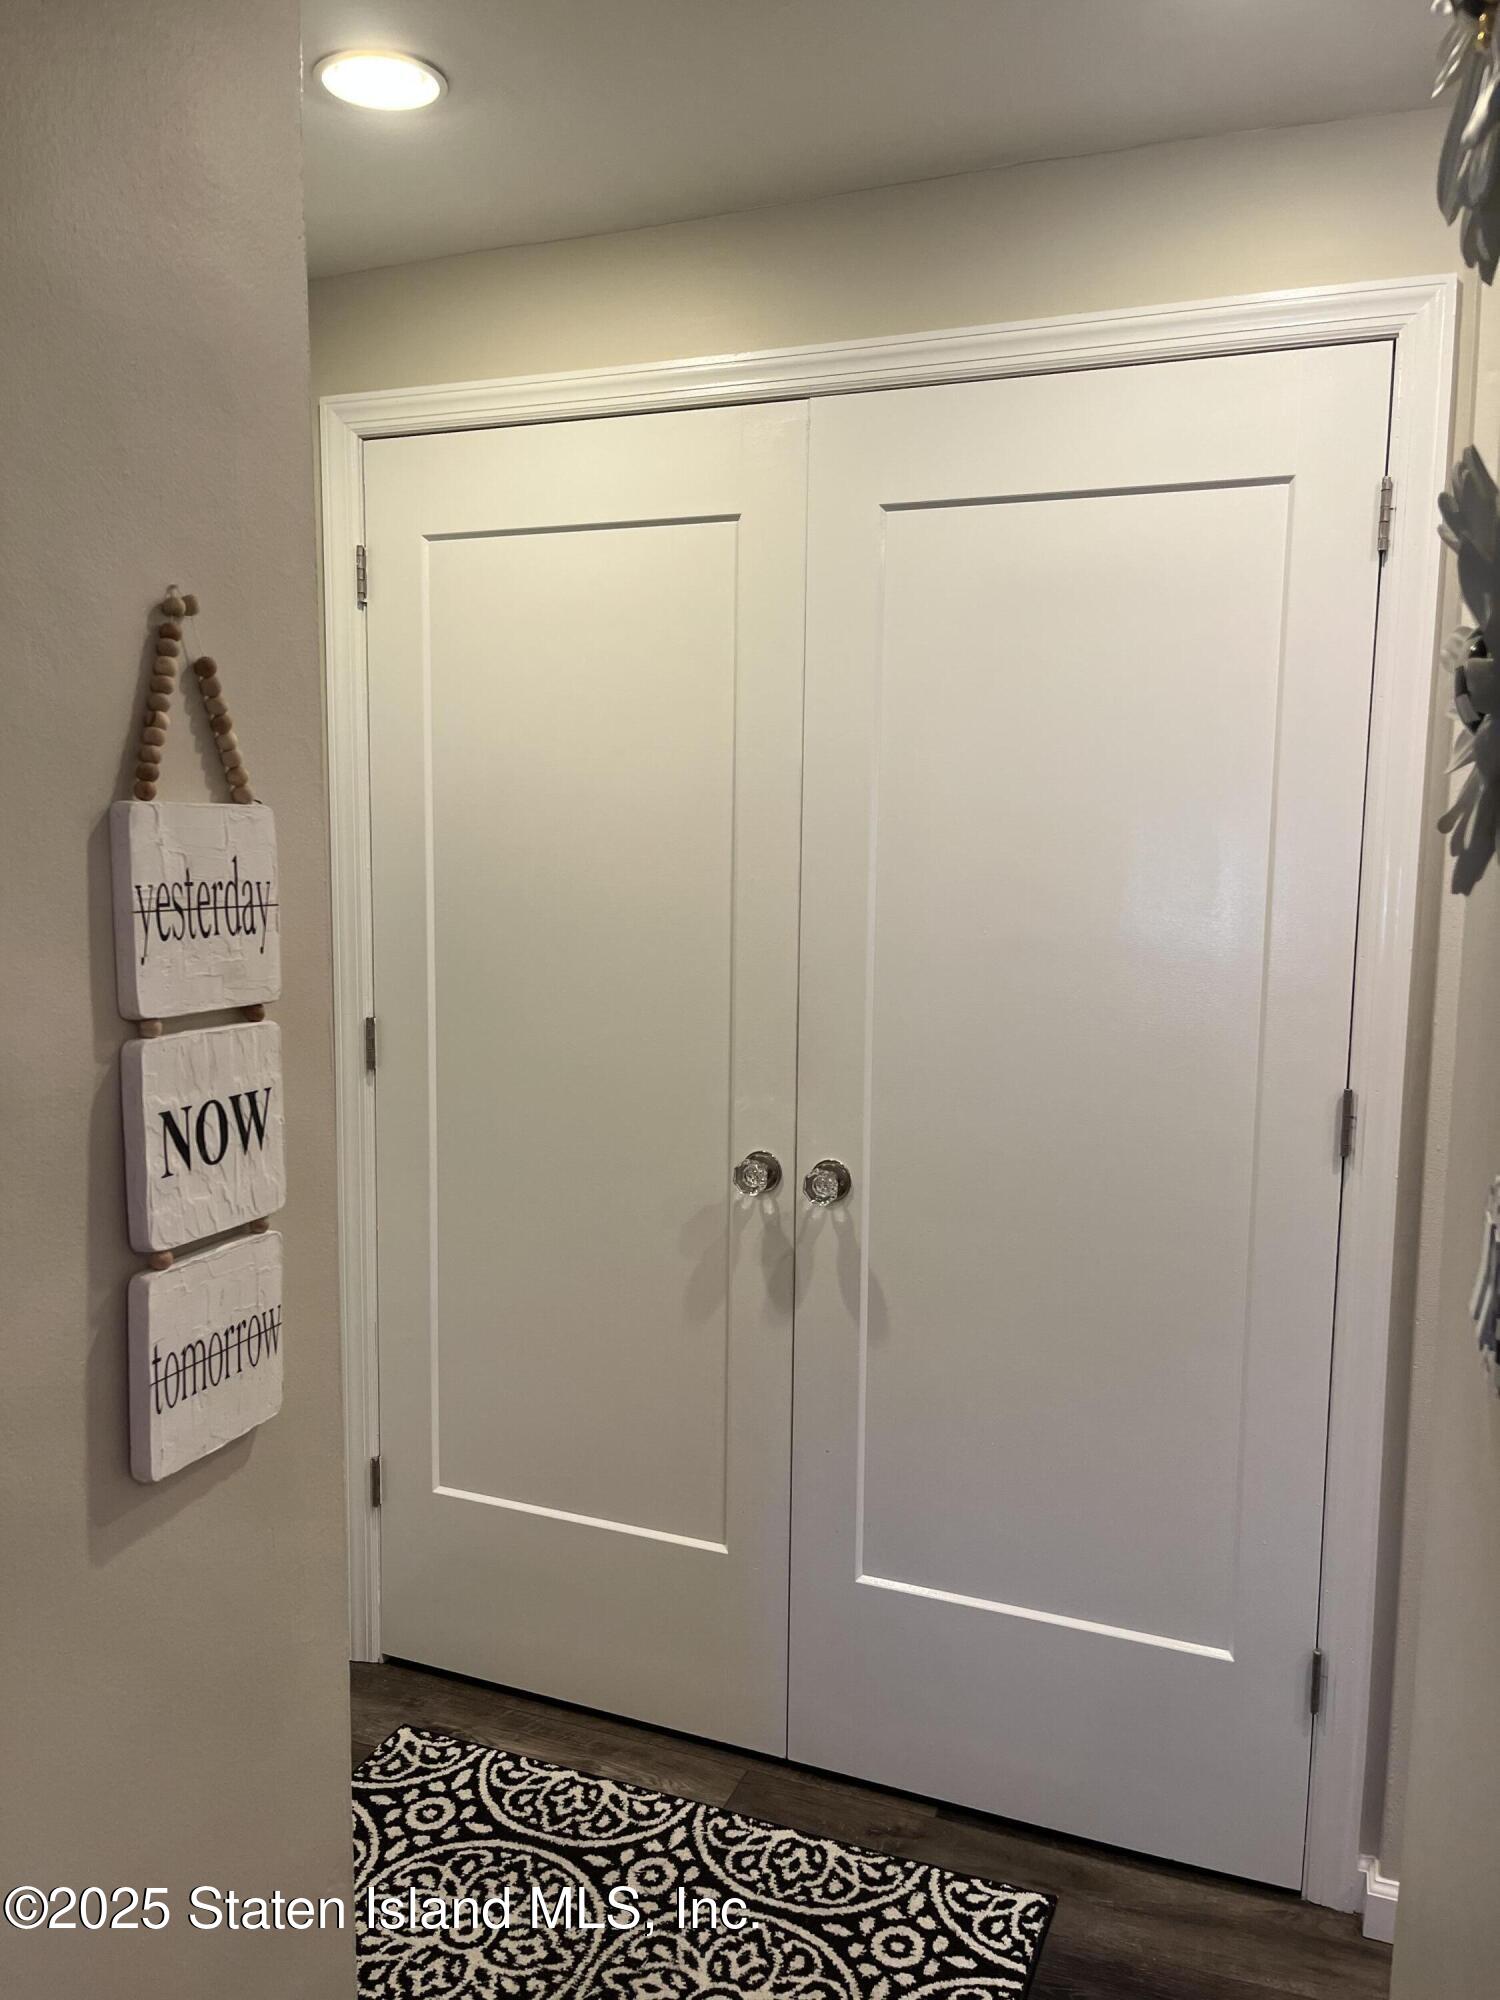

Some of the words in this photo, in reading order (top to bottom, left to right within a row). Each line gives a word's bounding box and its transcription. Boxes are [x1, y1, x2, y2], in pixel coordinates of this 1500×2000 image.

[133, 855, 274, 966] yesterday
[157, 1087, 272, 1179] NOW
[150, 1304, 281, 1415] tomorrow
